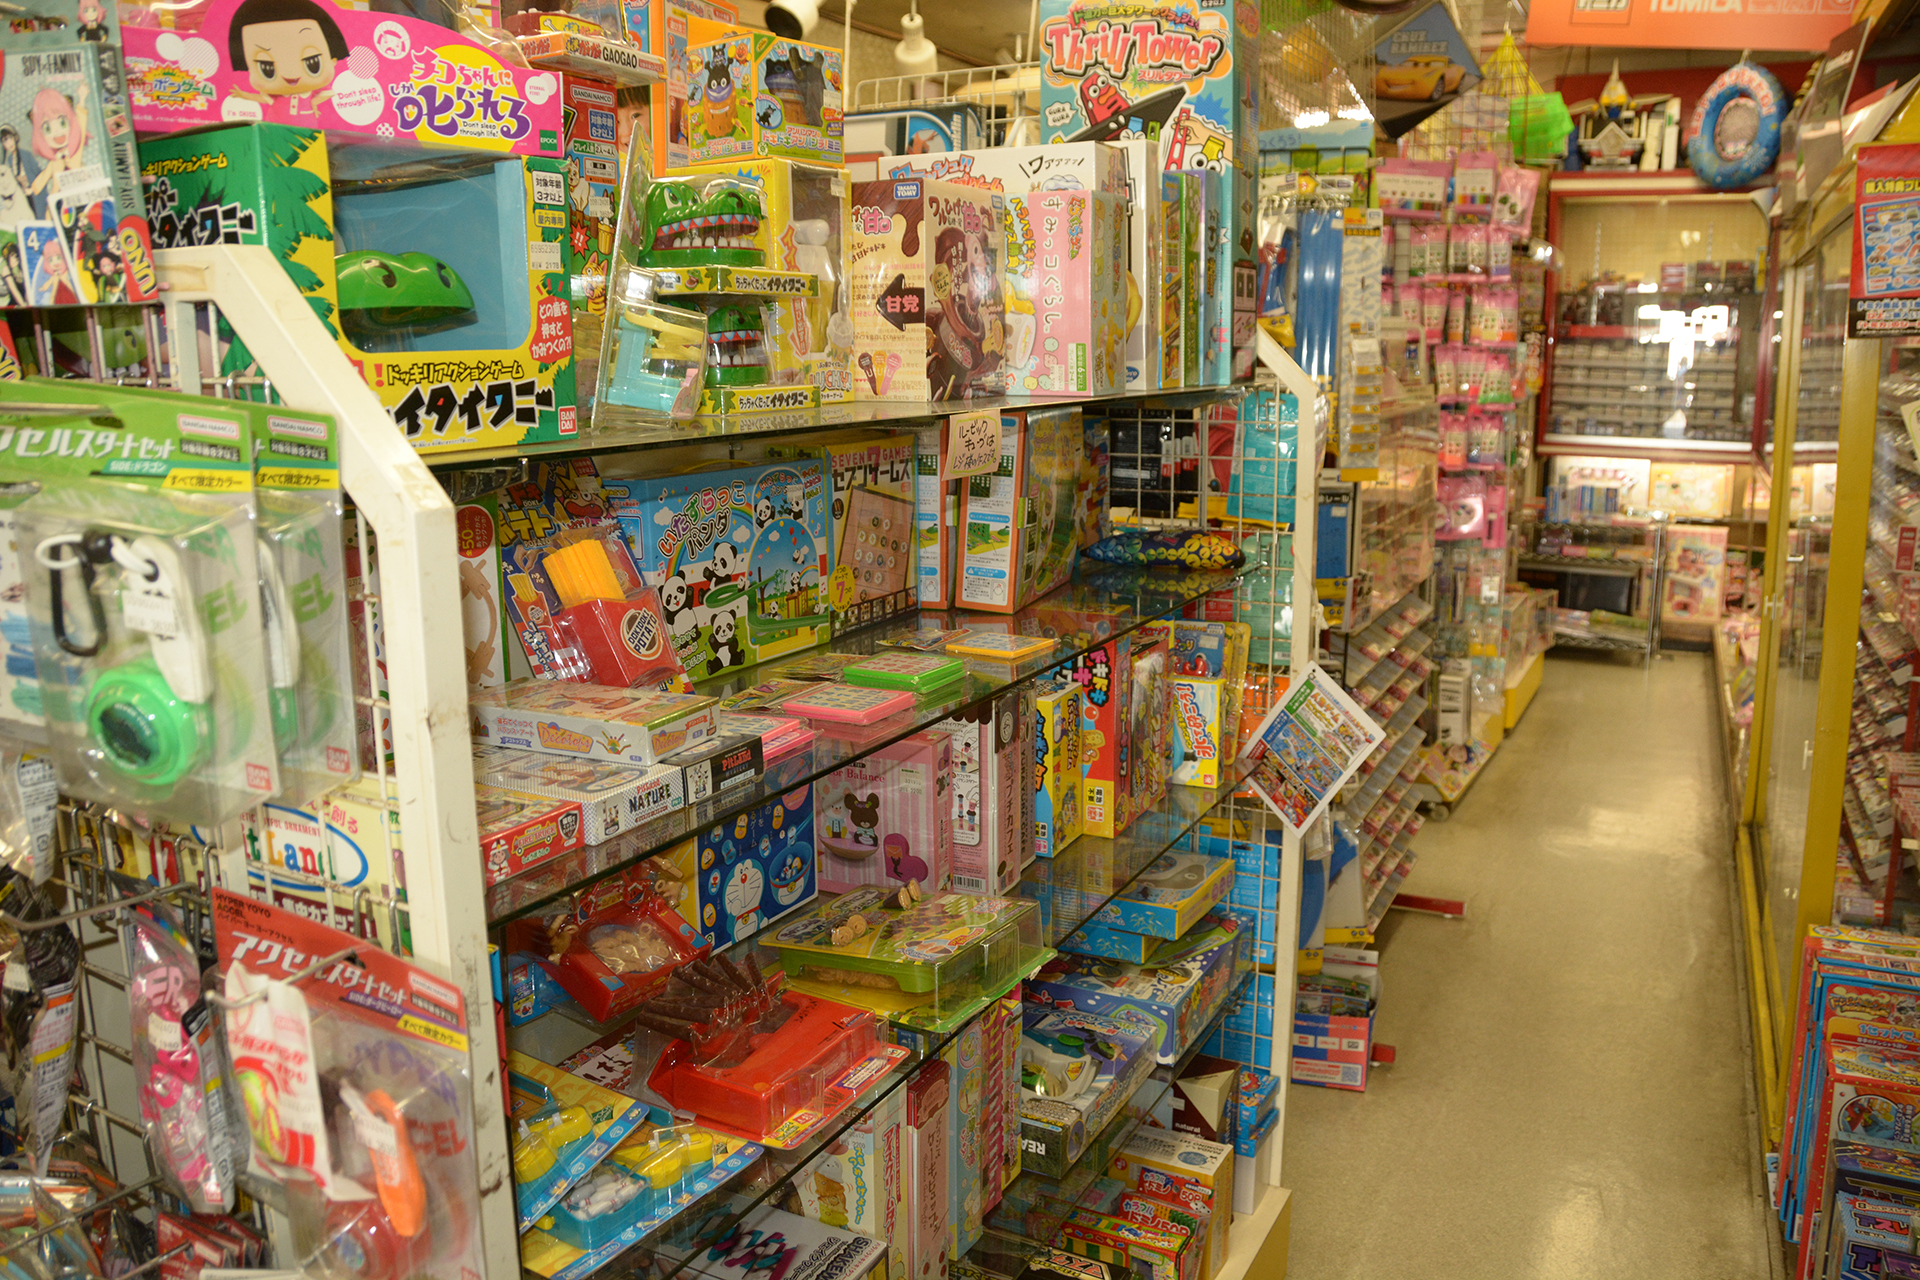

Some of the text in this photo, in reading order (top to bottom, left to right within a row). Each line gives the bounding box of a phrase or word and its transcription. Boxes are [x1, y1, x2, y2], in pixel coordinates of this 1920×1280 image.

[1047, 21, 1217, 73] Thrill Tower
[410, 47, 513, 87] チコちゃんに
[602, 46, 638, 69] GAOGAO
[1138, 69, 1193, 82] スリルタワー
[337, 87, 377, 101] Don't sleep
[337, 94, 381, 110] through life!
[573, 88, 613, 104] BANDAI NAMCO
[392, 84, 531, 139] 叱られる
[1048, 106, 1066, 117] GURA
[1051, 113, 1071, 125] GURA
[460, 128, 499, 138] through life!
[463, 121, 497, 131] Don't sleep
[142, 152, 228, 177] ッキリアクションゲーム
[536, 178, 562, 190] 対象年齢
[536, 191, 562, 203] 3才以上
[27, 231, 40, 250] 4
[119, 227, 157, 296] UNO
[1041, 196, 1064, 333] すみっコぐらし
[539, 302, 568, 317] どの歯を
[885, 295, 919, 313] 甘党
[541, 321, 564, 337] 押すと
[387, 361, 524, 386] ドッキリアクションゲーム
[394, 378, 556, 438] イタイワニー
[560, 411, 575, 422] BAN
[560, 420, 574, 430] DAI
[958, 419, 988, 439] ルービック
[831, 450, 866, 469] SEVEN
[882, 445, 912, 461] GAMES
[169, 474, 244, 488] すべて限定カラー
[257, 472, 331, 486] すべて限定カラー
[657, 480, 747, 558] いたずらっこ
[686, 505, 732, 559] パンダ
[627, 609, 651, 645] DOKIDOKI
[634, 613, 659, 655] POTATO
[722, 749, 752, 771] PitLand
[846, 768, 885, 783] Balance
[628, 783, 672, 814] NATURE
[518, 834, 535, 848] FIRE
[534, 827, 558, 843] TRUCK
[215, 892, 272, 919] HYPER YOYO
[216, 903, 246, 920] ACCEL
[1174, 1121, 1201, 1134] natural
[883, 1122, 898, 1247] アイスクリームタワー
[1179, 1190, 1202, 1203] 50P
[1122, 1198, 1156, 1217] カラフル
